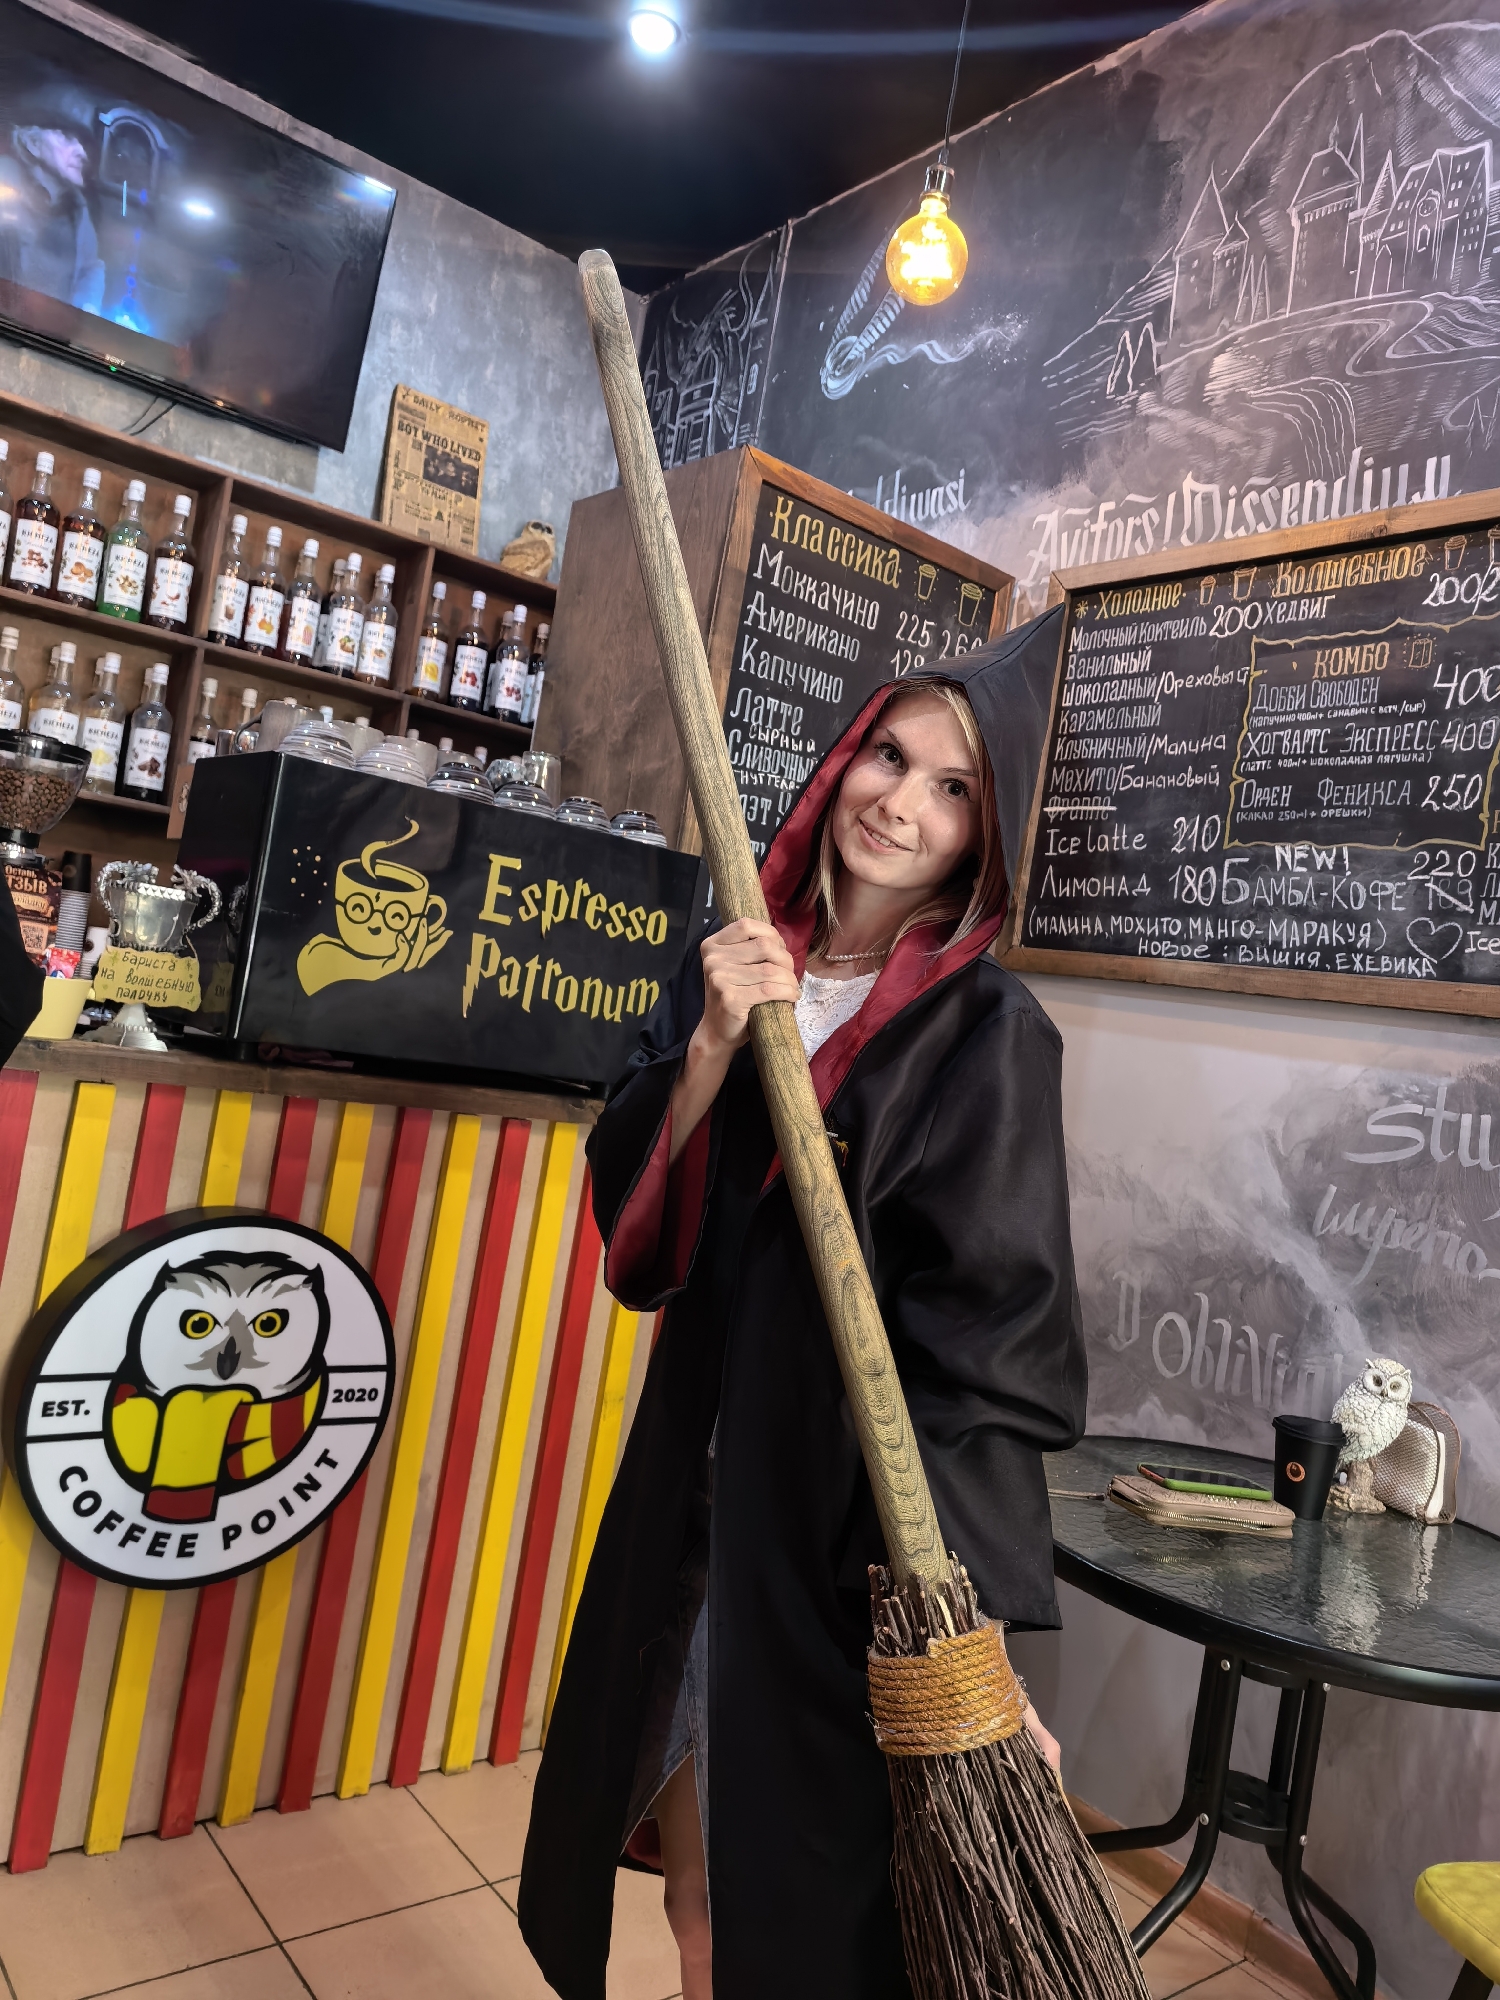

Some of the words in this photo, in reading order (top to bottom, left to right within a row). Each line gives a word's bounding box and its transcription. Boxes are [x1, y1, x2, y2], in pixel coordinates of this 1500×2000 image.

[422, 429, 448, 449] WHO
[450, 441, 481, 462] LIVED
[895, 611, 937, 647] 225
[1207, 602, 1264, 638] 200
[1313, 641, 1390, 679] КОМБО
[730, 688, 804, 736] Латте
[1421, 773, 1483, 812] 250
[1045, 829, 1081, 856] Ice
[1171, 814, 1221, 854] 210
[1168, 864, 1217, 907] 180
[1407, 849, 1476, 880] 220
[1274, 845, 1352, 876] NEW!
[478, 853, 668, 945] Espresso
[41, 1400, 91, 1418] EST.
[331, 1388, 378, 1403] 2020
[58, 1466, 199, 1559] COFFEE
[221, 1448, 340, 1550] POINT
